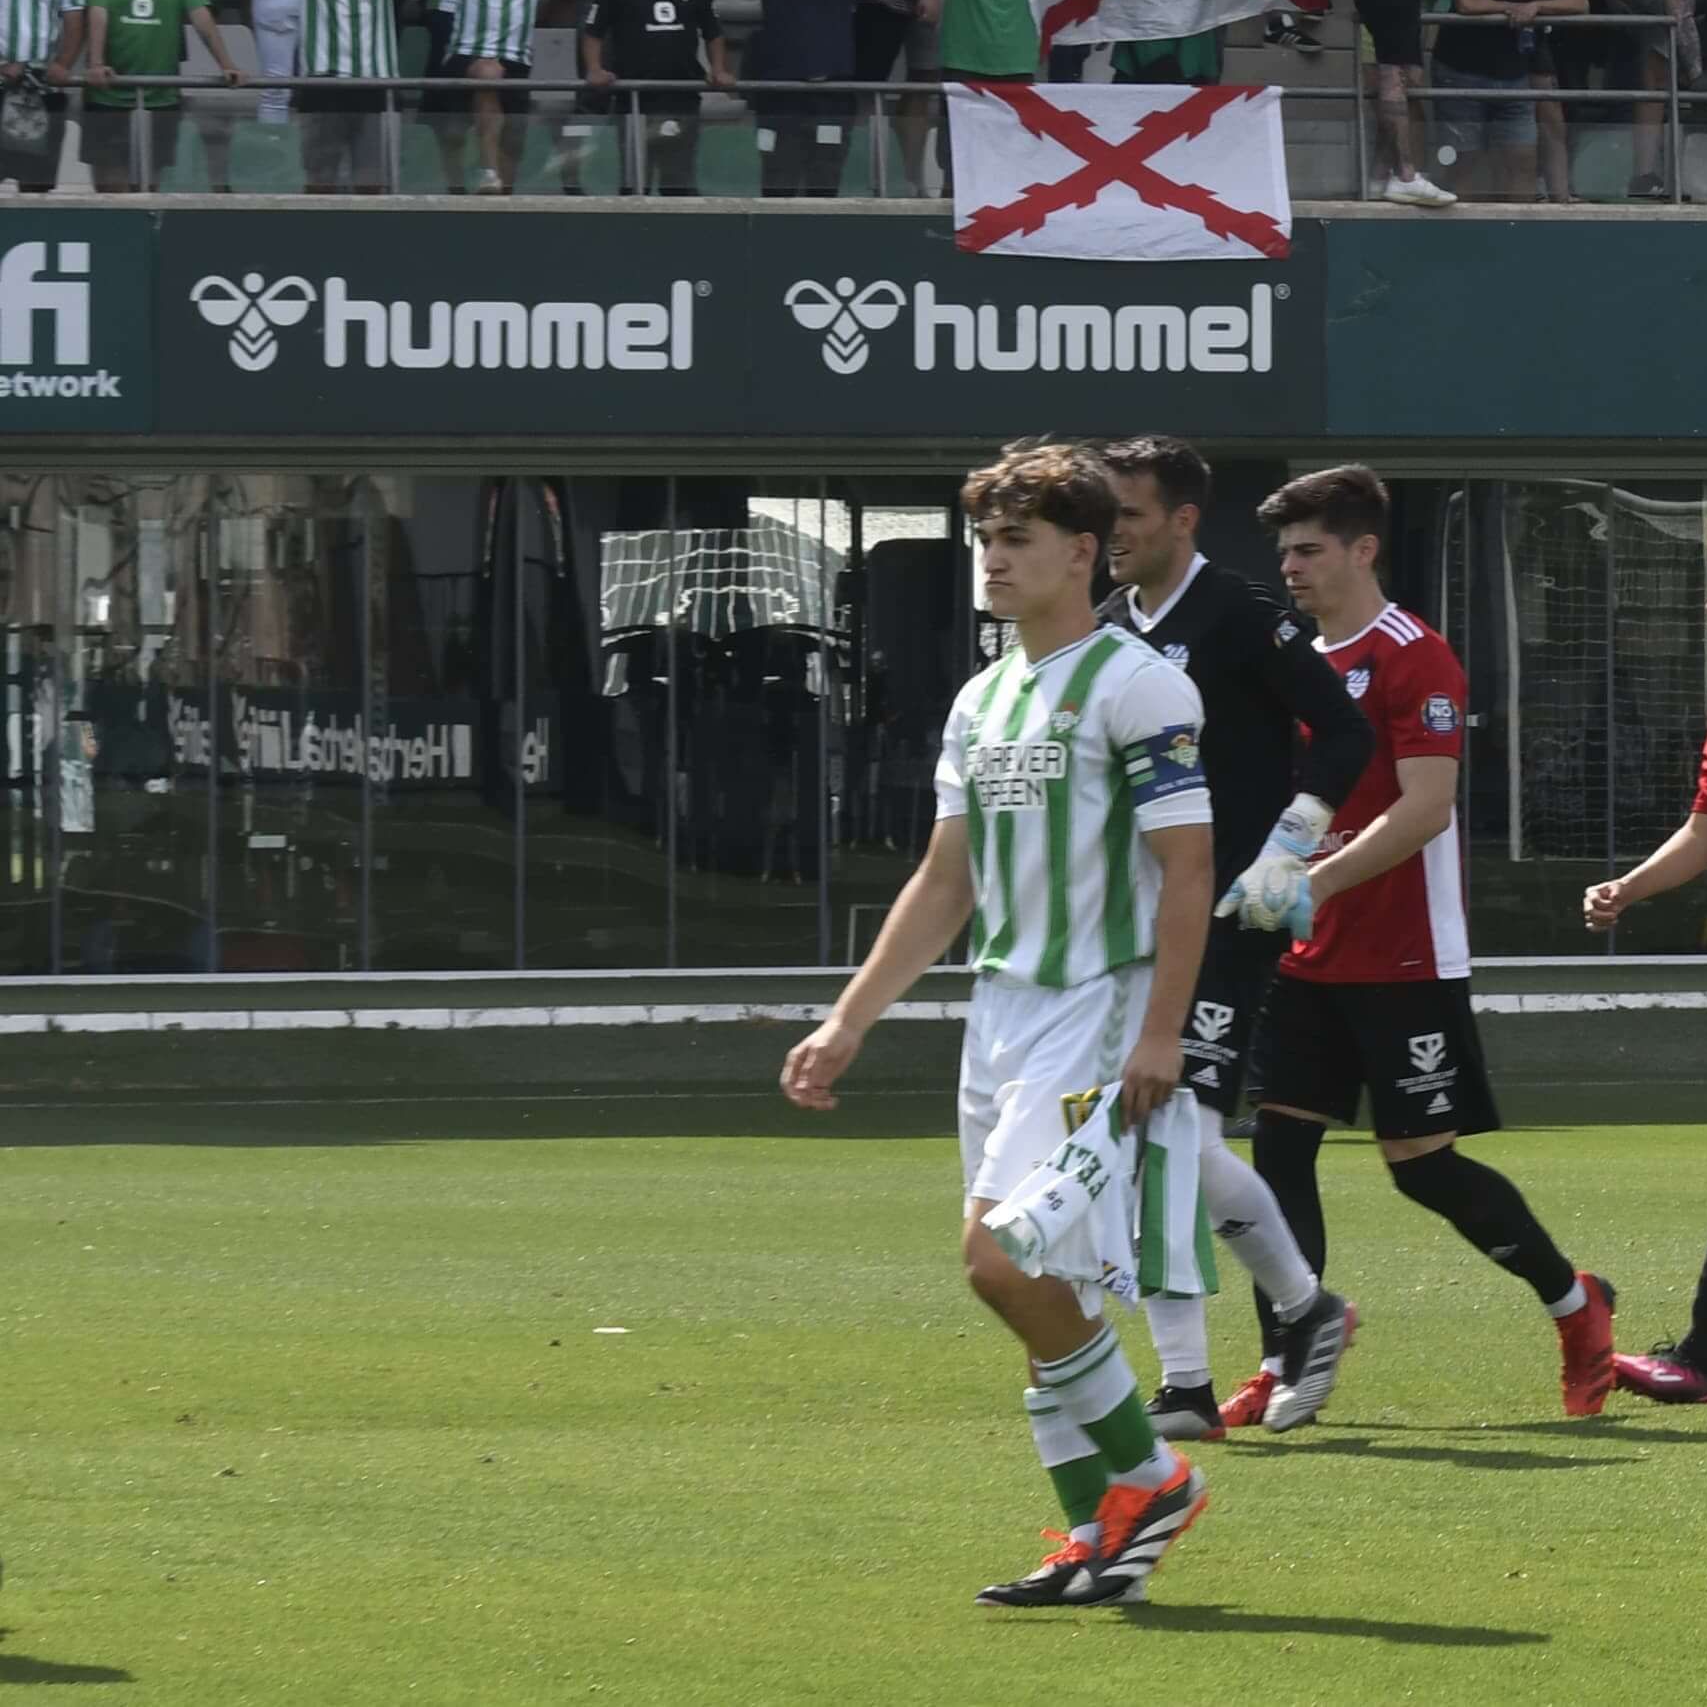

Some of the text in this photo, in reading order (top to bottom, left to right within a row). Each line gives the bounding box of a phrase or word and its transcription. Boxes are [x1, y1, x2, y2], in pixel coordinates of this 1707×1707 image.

[0, 241, 91, 365] fi
[326, 277, 692, 370] hummel
[914, 280, 1274, 372] hummel
